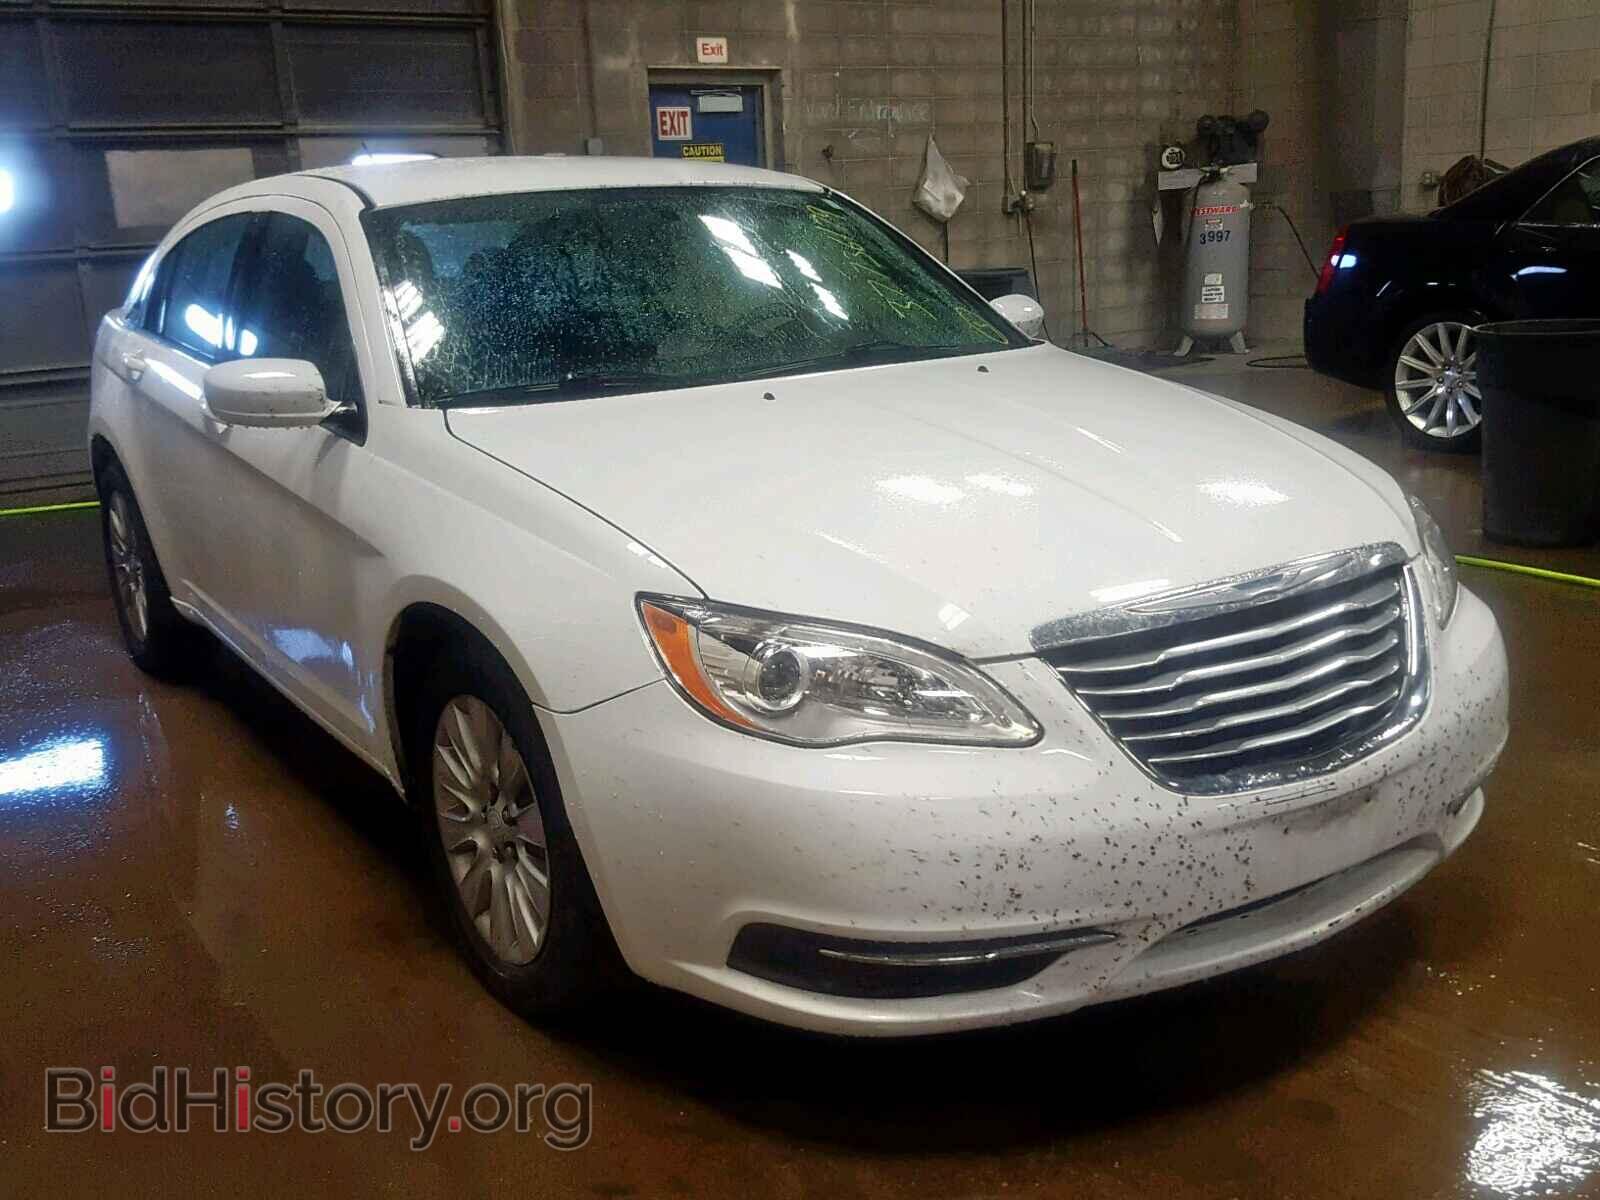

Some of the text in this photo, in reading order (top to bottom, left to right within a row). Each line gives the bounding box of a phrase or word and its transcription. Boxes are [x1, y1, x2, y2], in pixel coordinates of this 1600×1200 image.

[701, 43, 723, 56] Exit
[659, 111, 688, 136] EXIT
[682, 146, 722, 156] CAUTION
[1199, 230, 1231, 245] 3997
